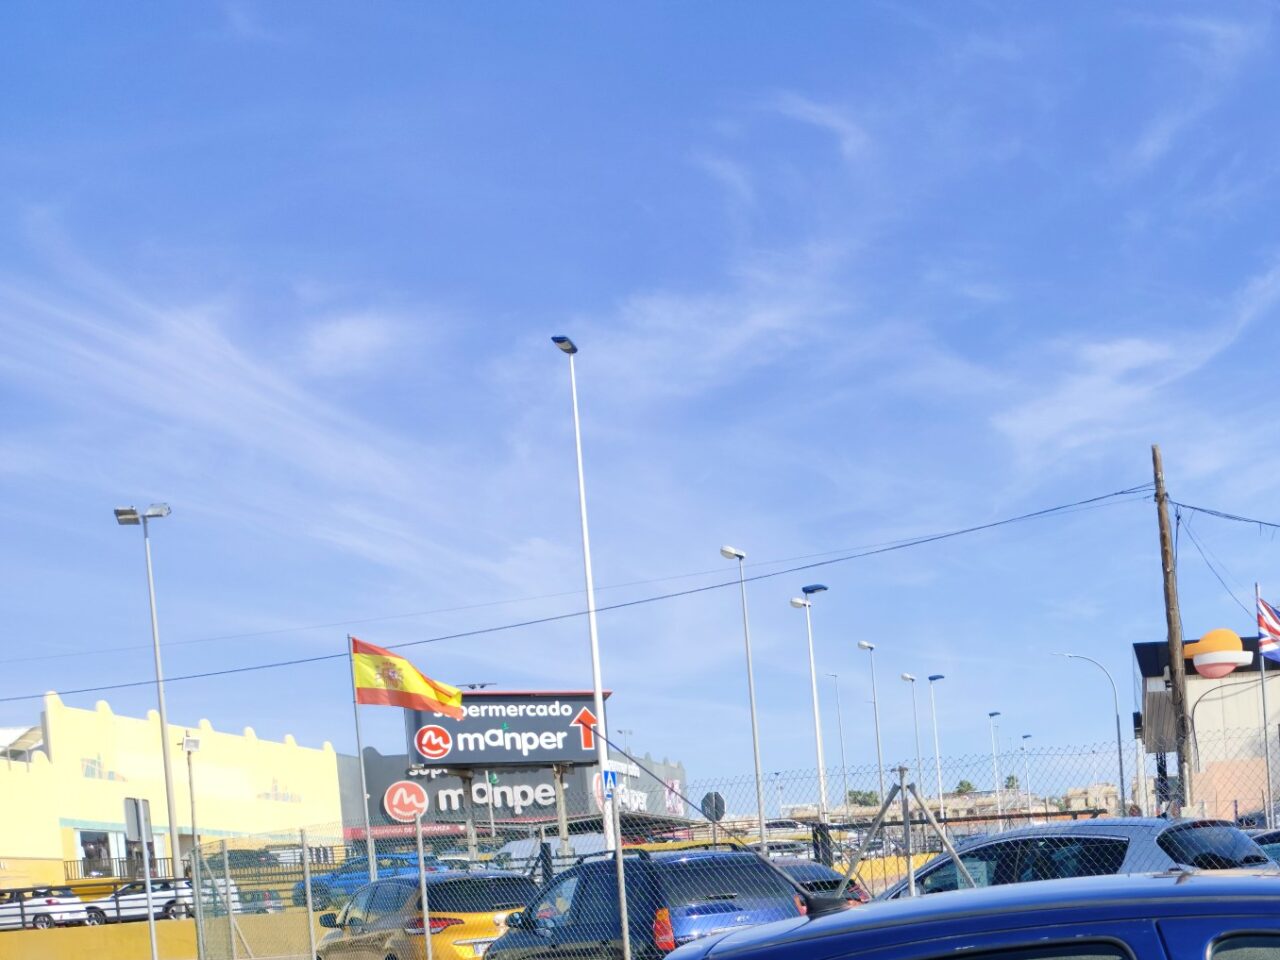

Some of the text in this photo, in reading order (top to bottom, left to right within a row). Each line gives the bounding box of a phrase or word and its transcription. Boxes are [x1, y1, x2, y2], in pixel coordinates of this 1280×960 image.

[434, 700, 573, 721] permercado
[457, 728, 568, 757] manper
[438, 782, 568, 814] manpe
